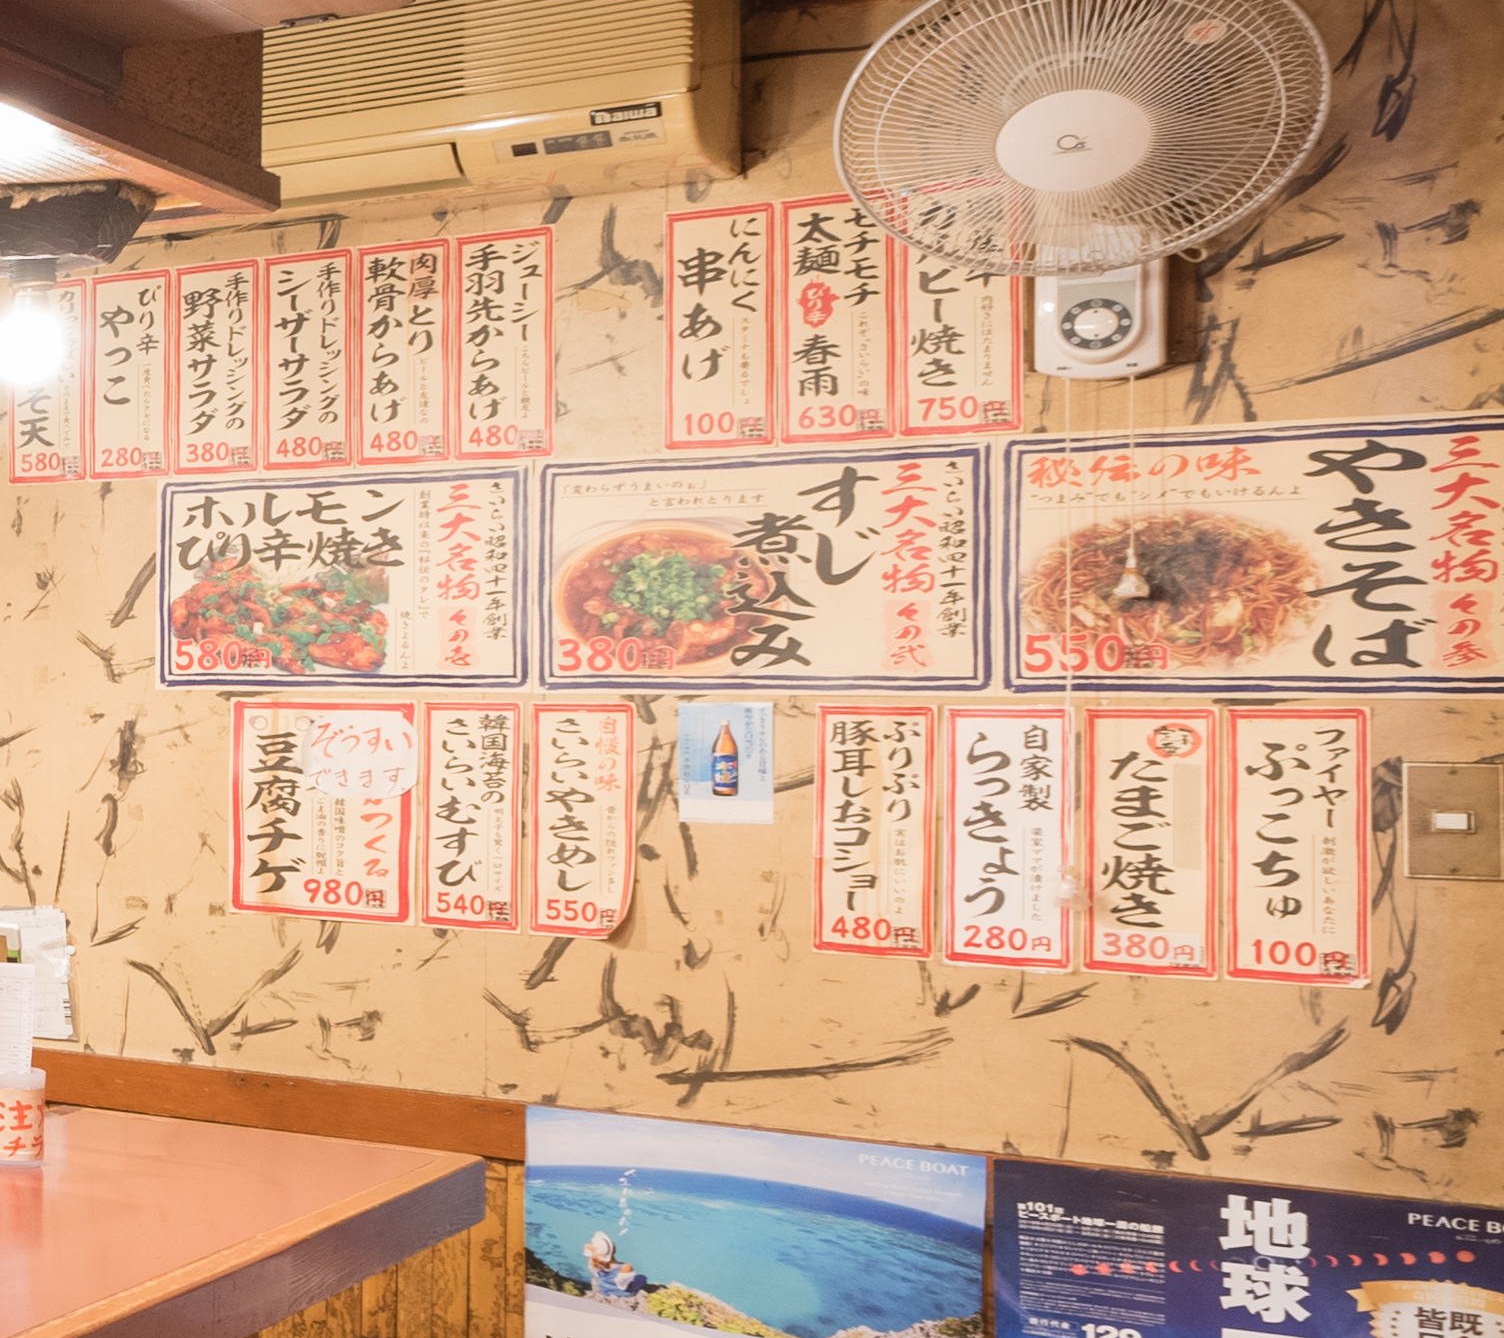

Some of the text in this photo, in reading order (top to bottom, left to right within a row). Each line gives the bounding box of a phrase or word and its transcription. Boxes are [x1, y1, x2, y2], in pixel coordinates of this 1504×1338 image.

[511, 241, 543, 341] ジューシー
[729, 216, 762, 314] にんにく
[792, 212, 844, 277] 太麺
[100, 305, 135, 405] やっこ
[137, 284, 162, 356] ぴり辛
[225, 272, 249, 430] 手作りドレッシングの
[274, 270, 313, 430] シーザーサラダ
[317, 262, 342, 424] 手作りドレッシングの
[365, 256, 408, 423] 軟骨からあげ
[409, 252, 439, 356] 肉厚とり
[465, 243, 508, 421] 手羽先からあげ
[676, 248, 731, 382] 串あげ
[182, 287, 223, 436] 野菜サラダ
[793, 334, 842, 397] 春雨
[184, 488, 406, 530] ホルモン
[1025, 445, 1263, 489] 秘伝の味
[1428, 435, 1501, 584] 三大名物
[177, 526, 407, 572] ぴり辛焼き
[435, 483, 482, 600] 三大名物
[797, 466, 881, 586] すじ
[880, 462, 938, 594] 三大名物
[1303, 439, 1439, 668] やきそば
[727, 513, 817, 669] 煮込み
[308, 767, 406, 793] できます
[311, 722, 413, 758] ぞうすい
[477, 714, 511, 804] 韓国海苔の
[593, 716, 622, 793] 自慢の味
[881, 720, 921, 823] ぷりぷり
[1018, 725, 1054, 812] 自家製
[1312, 727, 1351, 830] ファイヤー
[245, 731, 306, 895] 豆腐チゲ
[434, 717, 484, 888] さいらいむすび
[545, 717, 597, 891] さいらいやきめし
[830, 720, 879, 911] 豚耳しおコショー
[963, 731, 1020, 917] らっきょう
[1102, 751, 1175, 927] たまご焼き
[1245, 742, 1311, 919] ぷっこちゅ
[963, 925, 1052, 953] 280円
[1102, 931, 1197, 963] 380円
[859, 1154, 969, 1176] PEACE BOAT
[1408, 1213, 1481, 1232] PEACE
